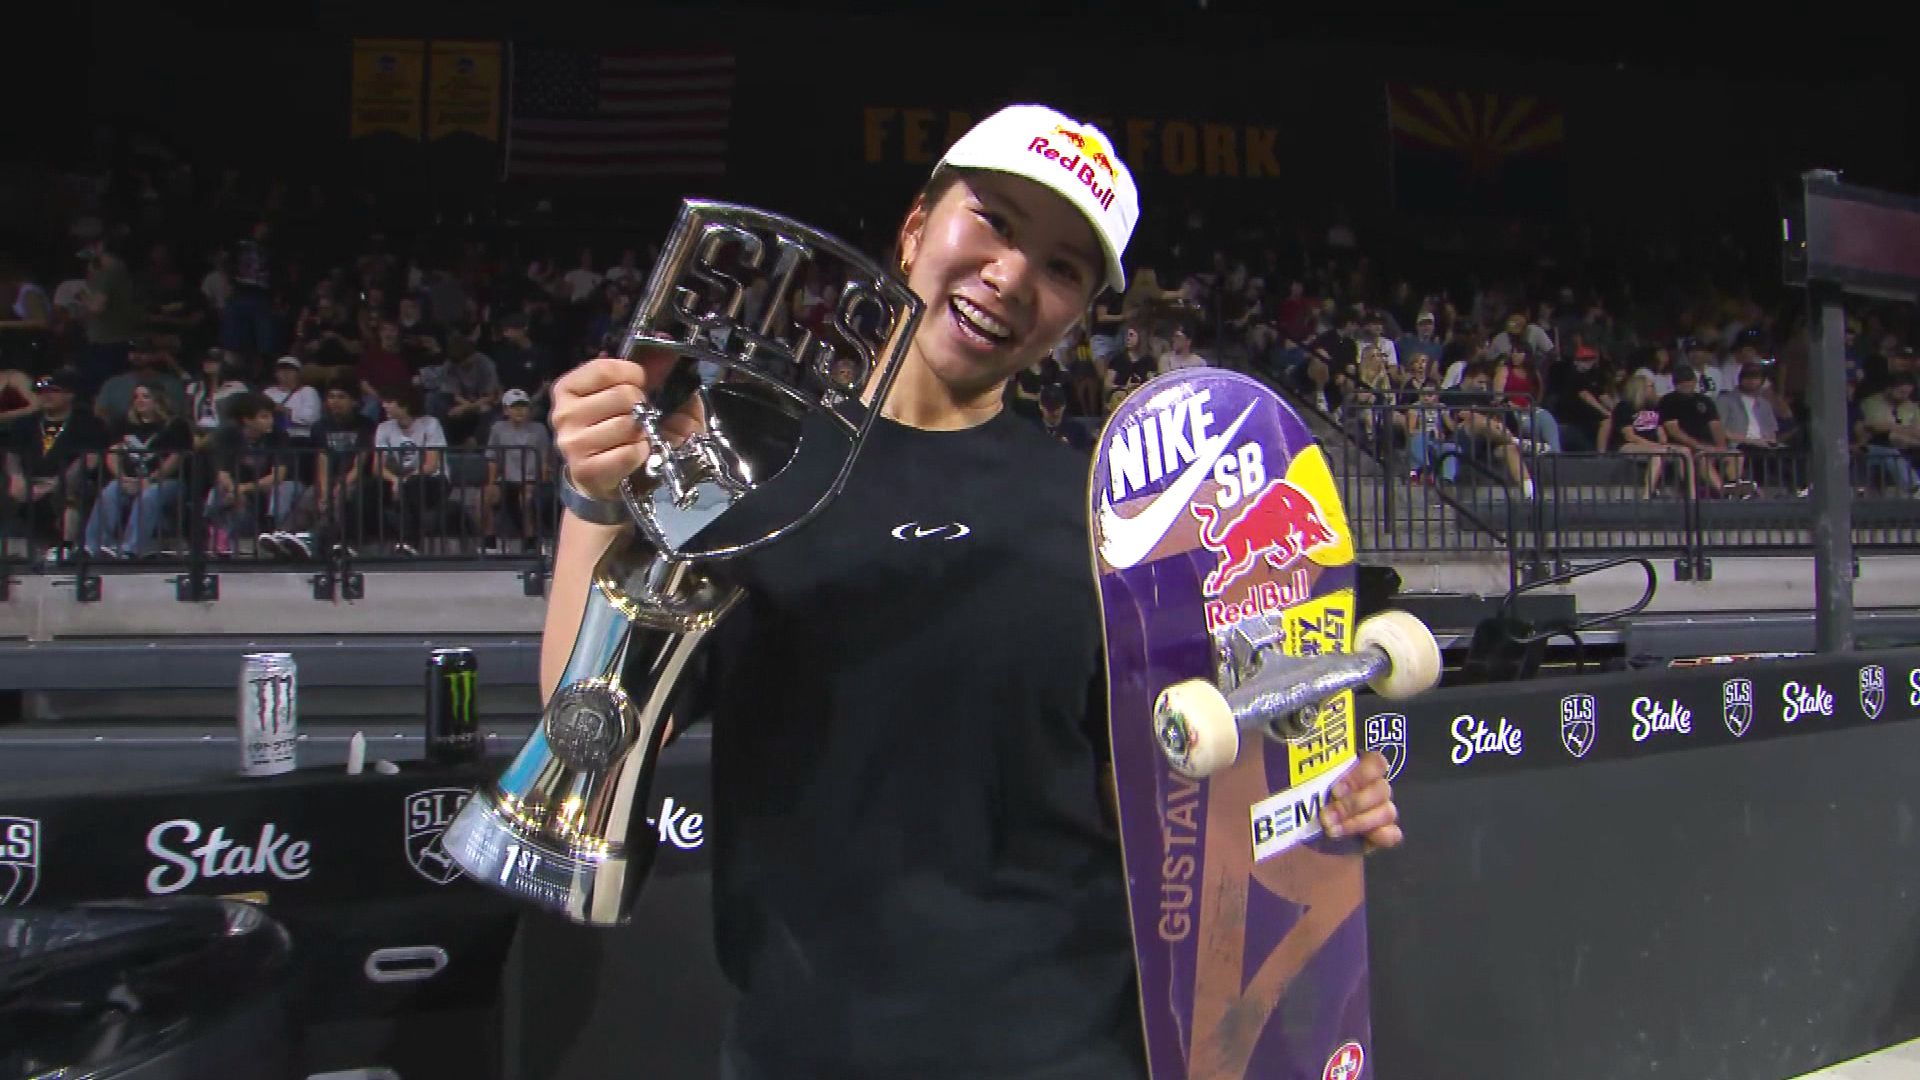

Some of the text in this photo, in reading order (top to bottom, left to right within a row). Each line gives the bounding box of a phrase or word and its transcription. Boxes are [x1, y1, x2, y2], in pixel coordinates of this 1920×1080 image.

[1124, 116, 1281, 177] FORK
[671, 222, 895, 402] SLS
[1108, 388, 1220, 502] NIKE
[1214, 440, 1266, 508] SB
[1725, 682, 1751, 704] SLS
[1782, 681, 1833, 722] Stake
[1861, 666, 1884, 689] SLS
[1324, 696, 1348, 762] RIDE
[1368, 717, 1404, 744] SLS
[1563, 698, 1593, 722] SLS
[1631, 696, 1692, 741] Stake
[1450, 714, 1523, 764] Stake
[146, 818, 311, 894] Stake
